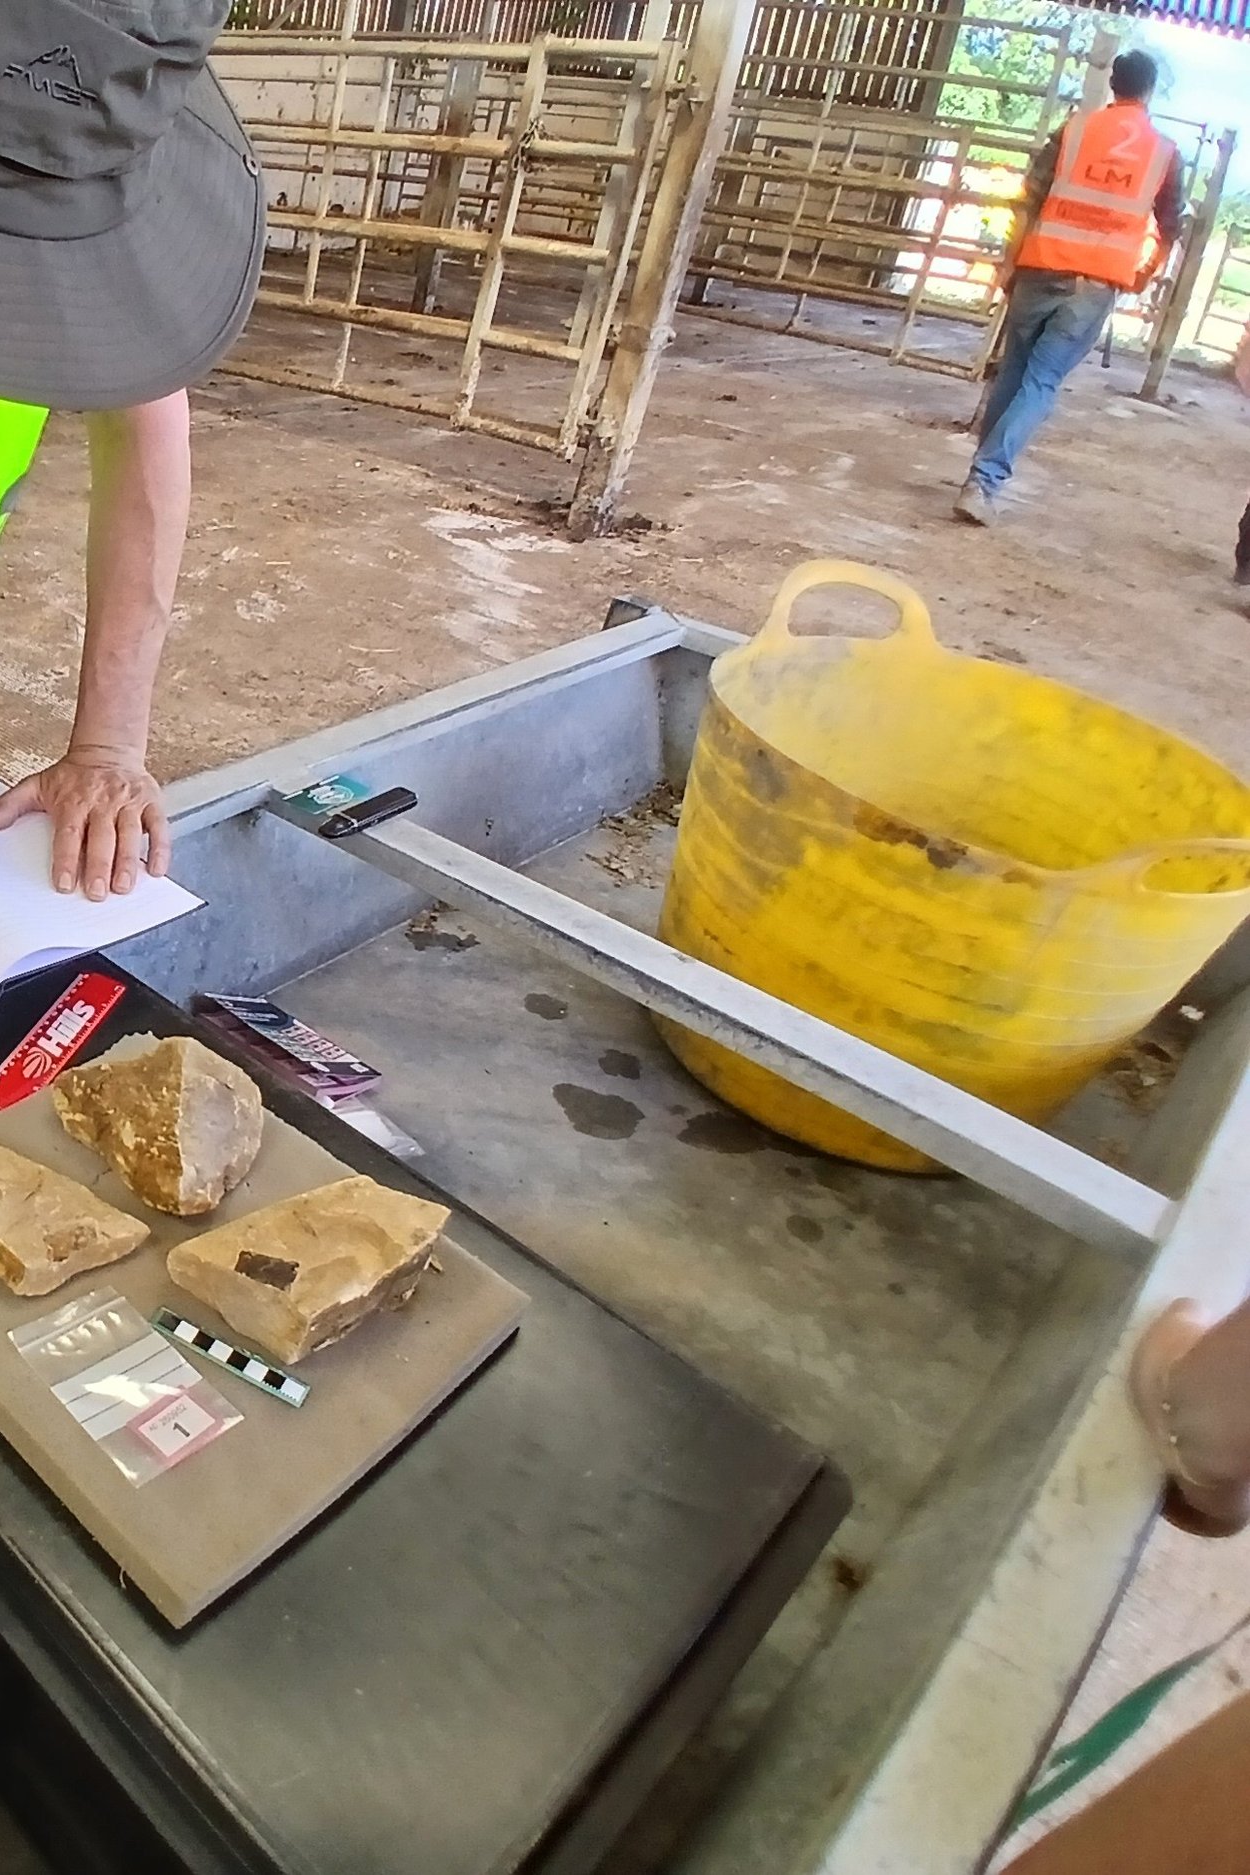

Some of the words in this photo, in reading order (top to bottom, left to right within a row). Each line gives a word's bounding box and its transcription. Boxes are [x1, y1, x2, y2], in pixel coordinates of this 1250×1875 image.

[1109, 119, 1141, 160] 2
[1085, 165, 1132, 188] LM
[37, 999, 96, 1058] Hills
[173, 1423, 190, 1437] 1
